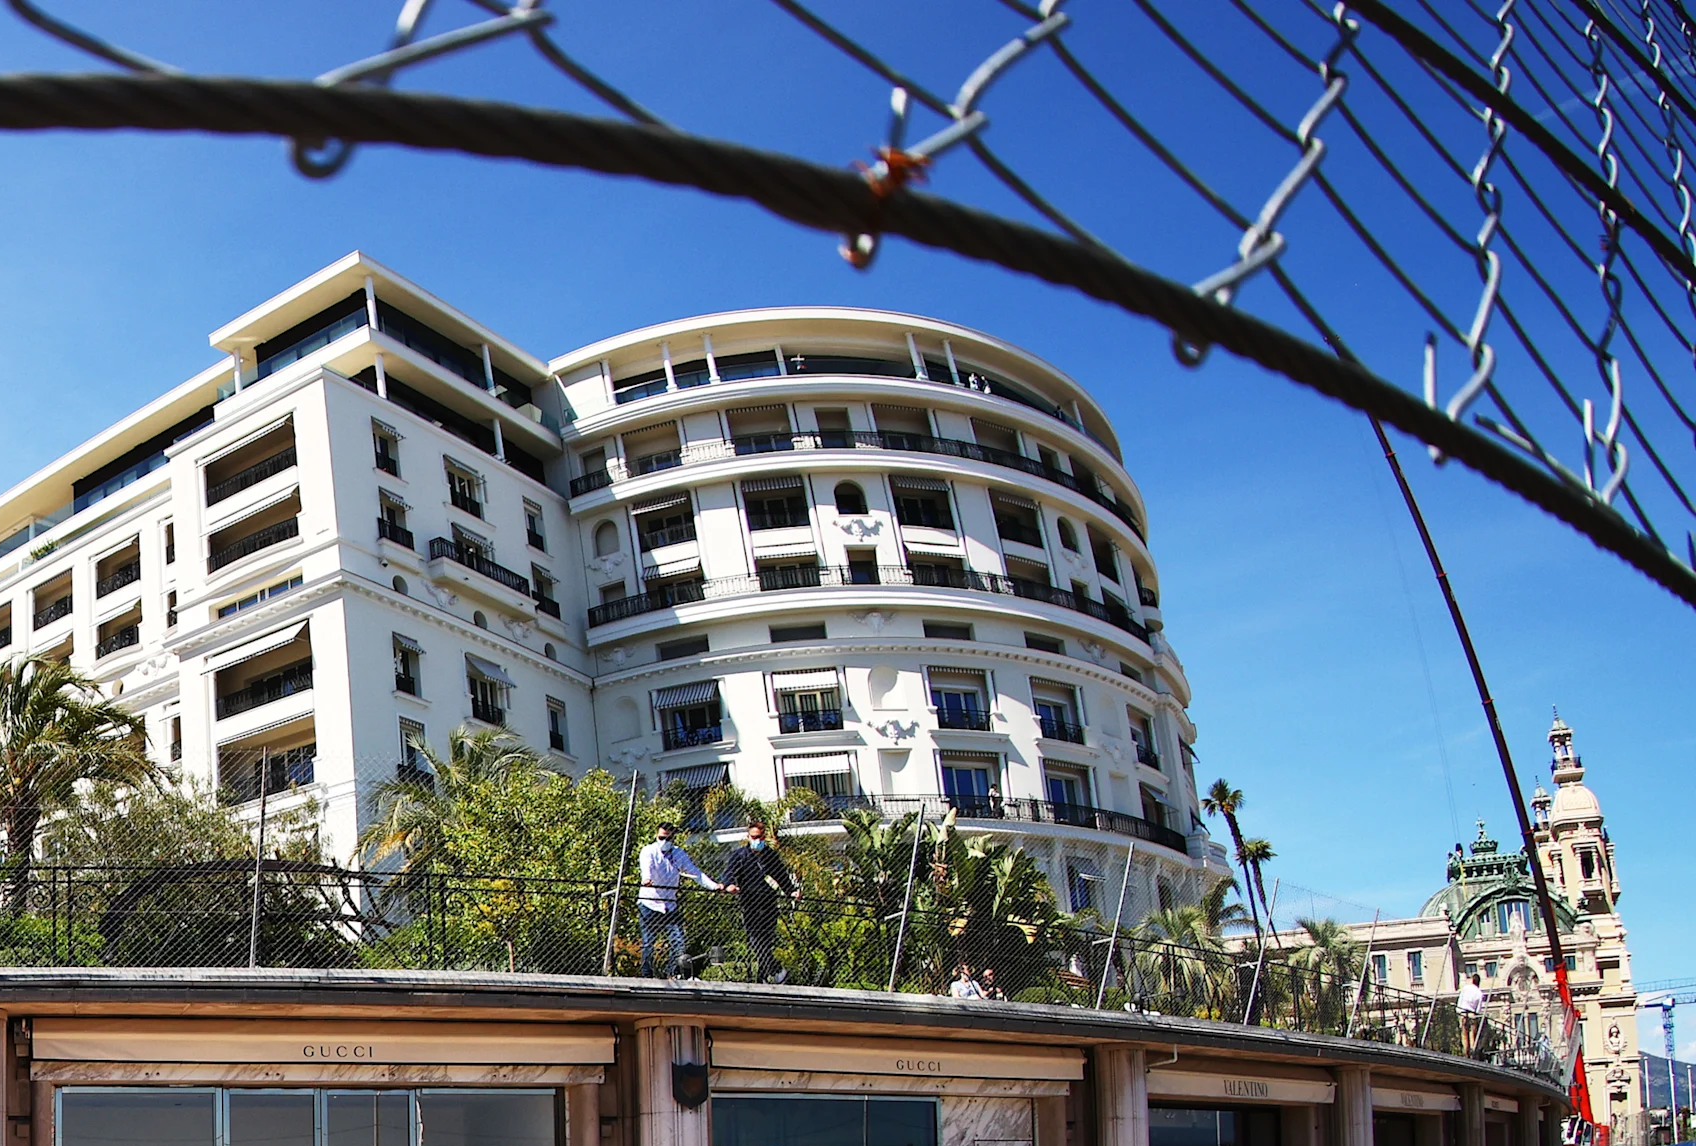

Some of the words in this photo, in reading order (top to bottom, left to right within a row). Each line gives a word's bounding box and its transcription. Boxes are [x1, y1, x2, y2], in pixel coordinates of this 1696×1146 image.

[303, 1045, 373, 1058] GUCCI
[896, 1059, 941, 1072] GUCCI
[1224, 1080, 1268, 1098] VALENTINO
